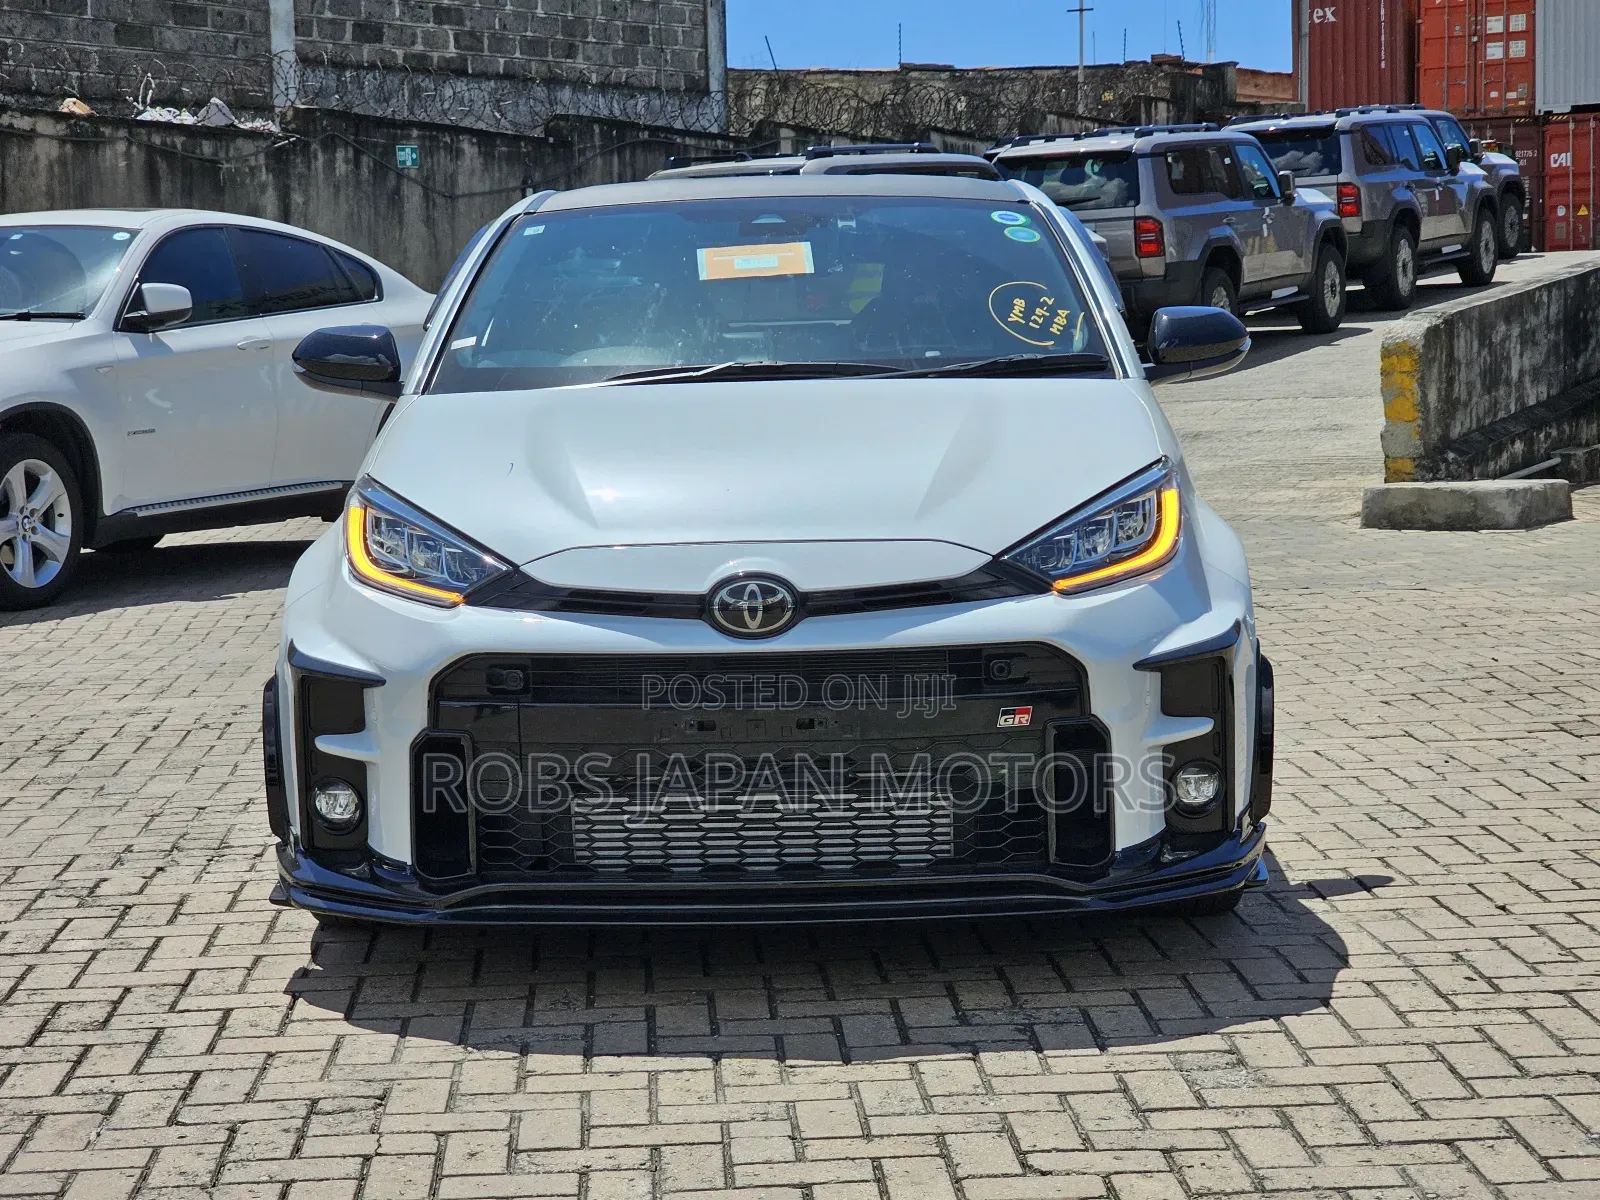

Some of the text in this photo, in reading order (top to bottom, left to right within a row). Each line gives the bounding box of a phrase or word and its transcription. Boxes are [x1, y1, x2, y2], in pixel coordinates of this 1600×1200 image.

[1308, 6, 1337, 24] ex
[1007, 297, 1026, 325] YMB
[1049, 309, 1071, 335] MBA
[999, 713, 1030, 726] GR
